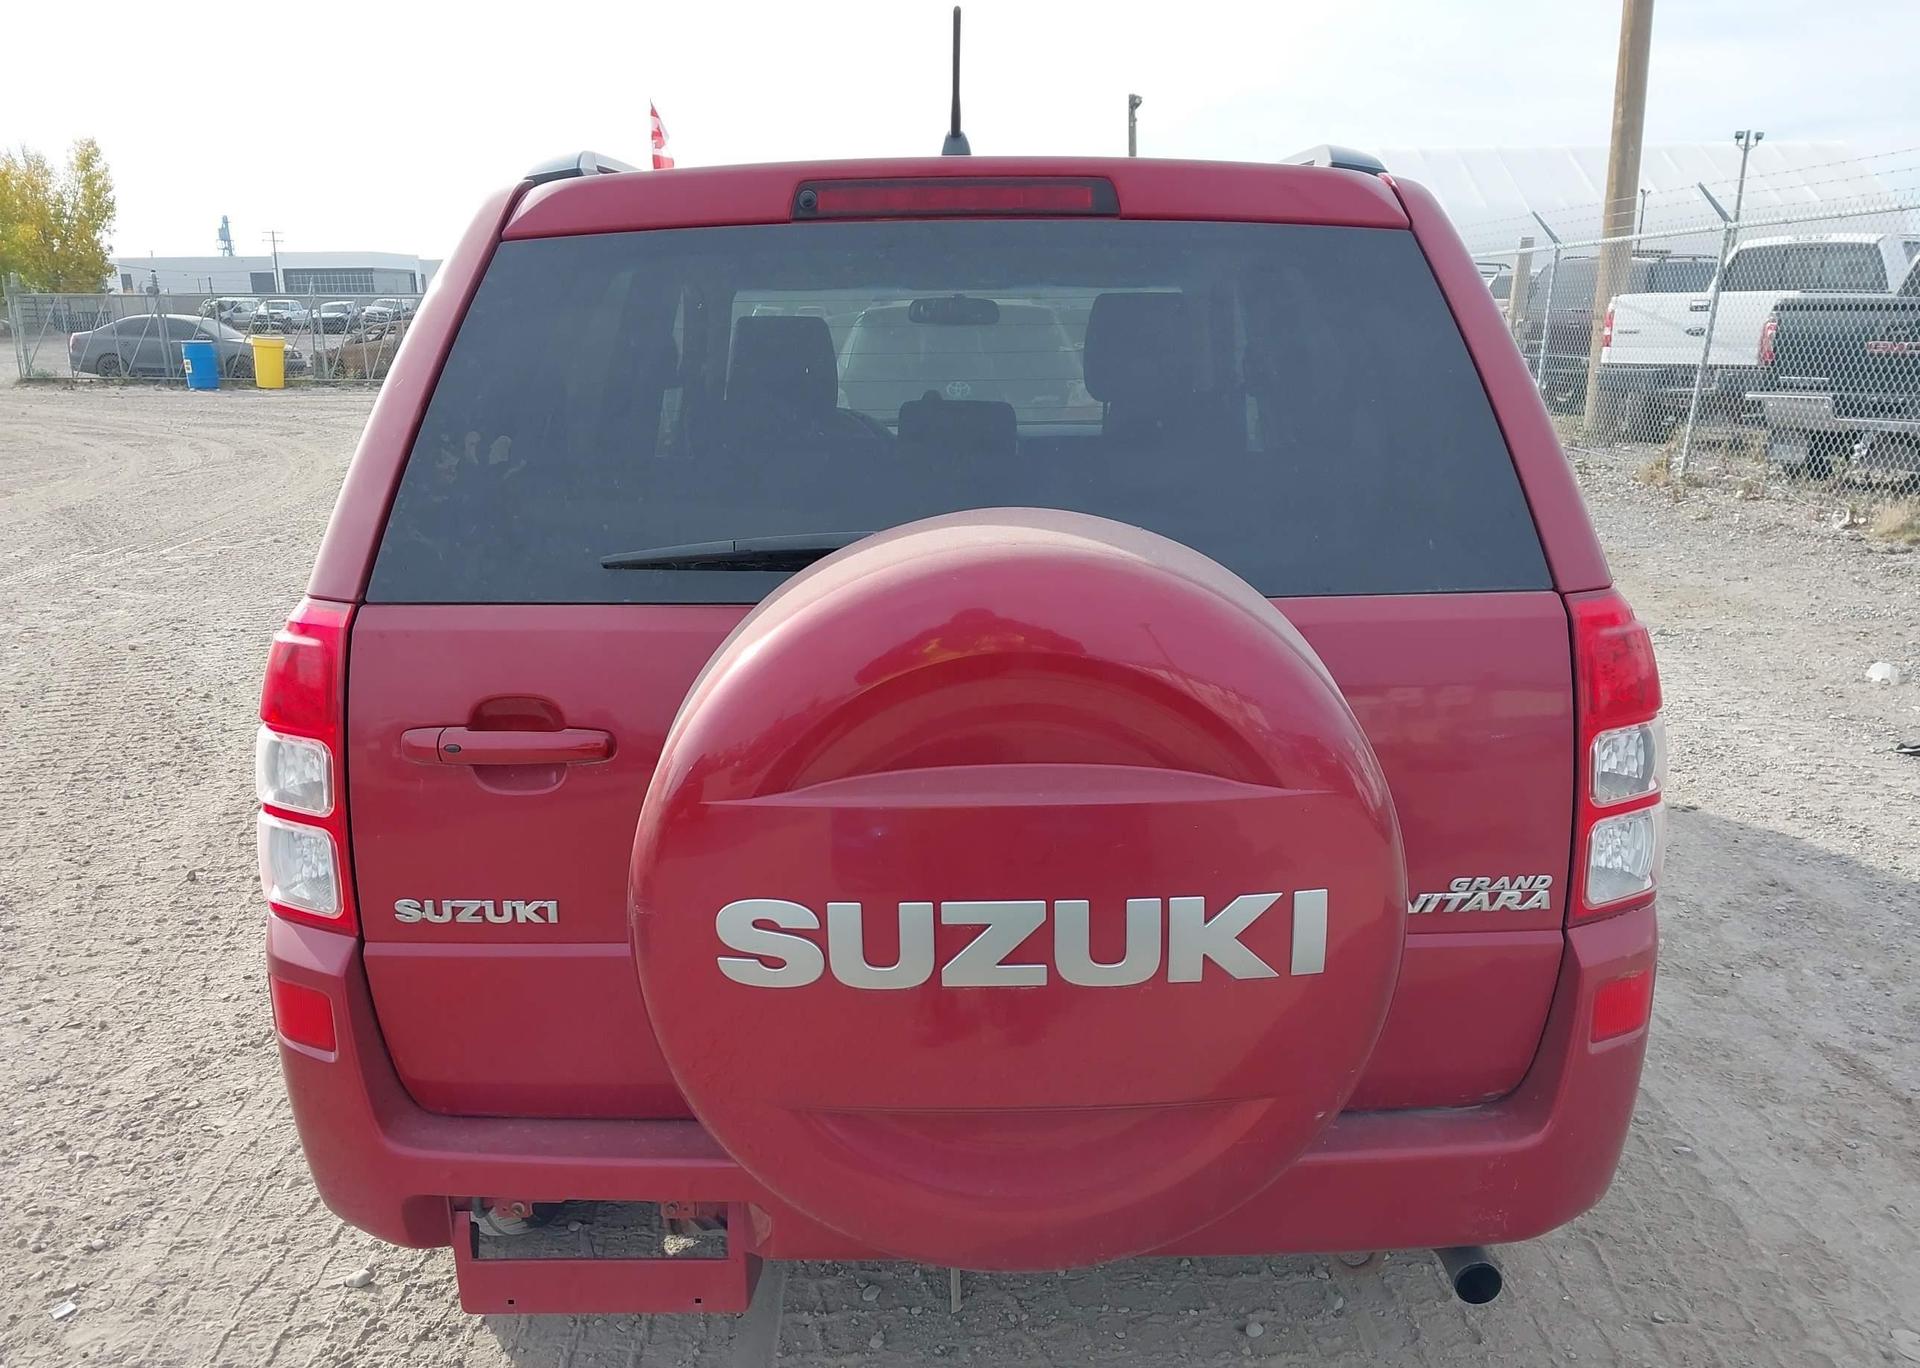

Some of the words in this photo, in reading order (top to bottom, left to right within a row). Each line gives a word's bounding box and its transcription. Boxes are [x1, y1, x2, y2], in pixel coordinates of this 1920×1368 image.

[1450, 875, 1553, 891] GRAND
[394, 898, 559, 924] SUZUKI
[715, 888, 1329, 990] SUZUKI
